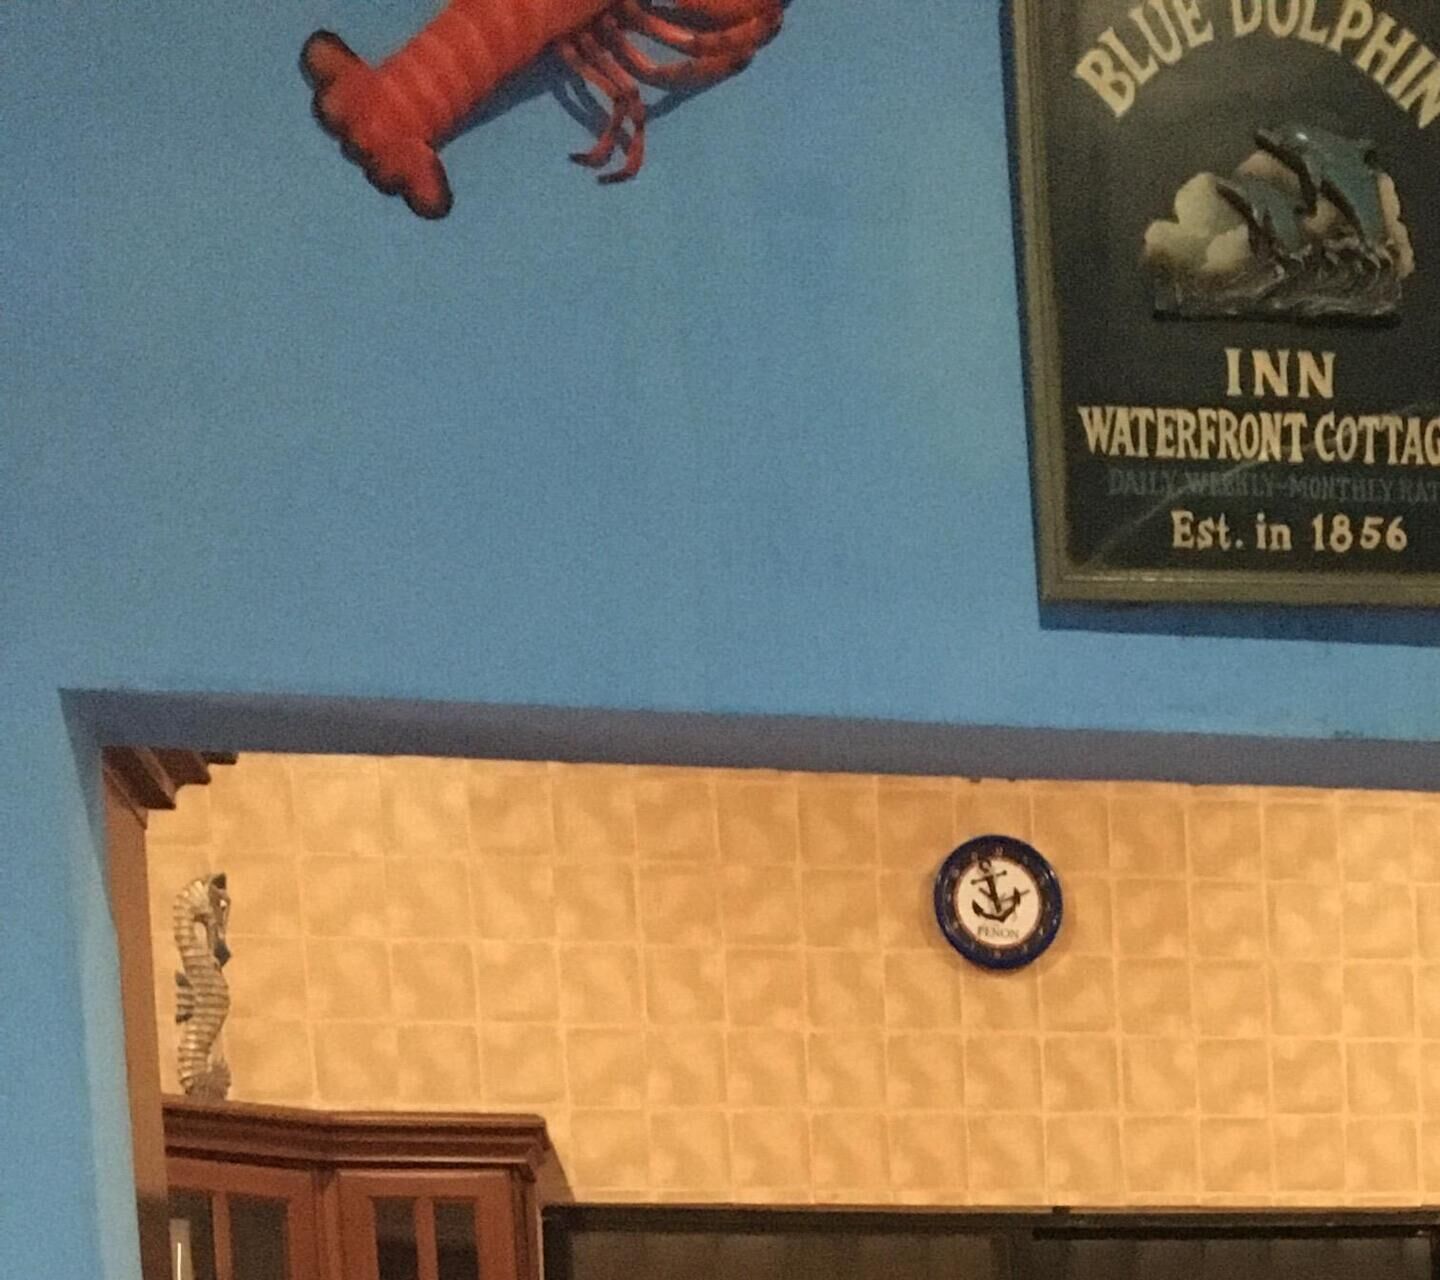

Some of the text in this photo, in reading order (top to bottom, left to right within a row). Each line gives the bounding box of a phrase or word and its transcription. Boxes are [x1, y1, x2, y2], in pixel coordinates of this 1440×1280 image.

[1075, 0, 1214, 118] BLUE
[1225, 348, 1337, 400] INN
[1078, 406, 1307, 463] WATERFRONT
[1171, 509, 1408, 552] Est. in 1856
